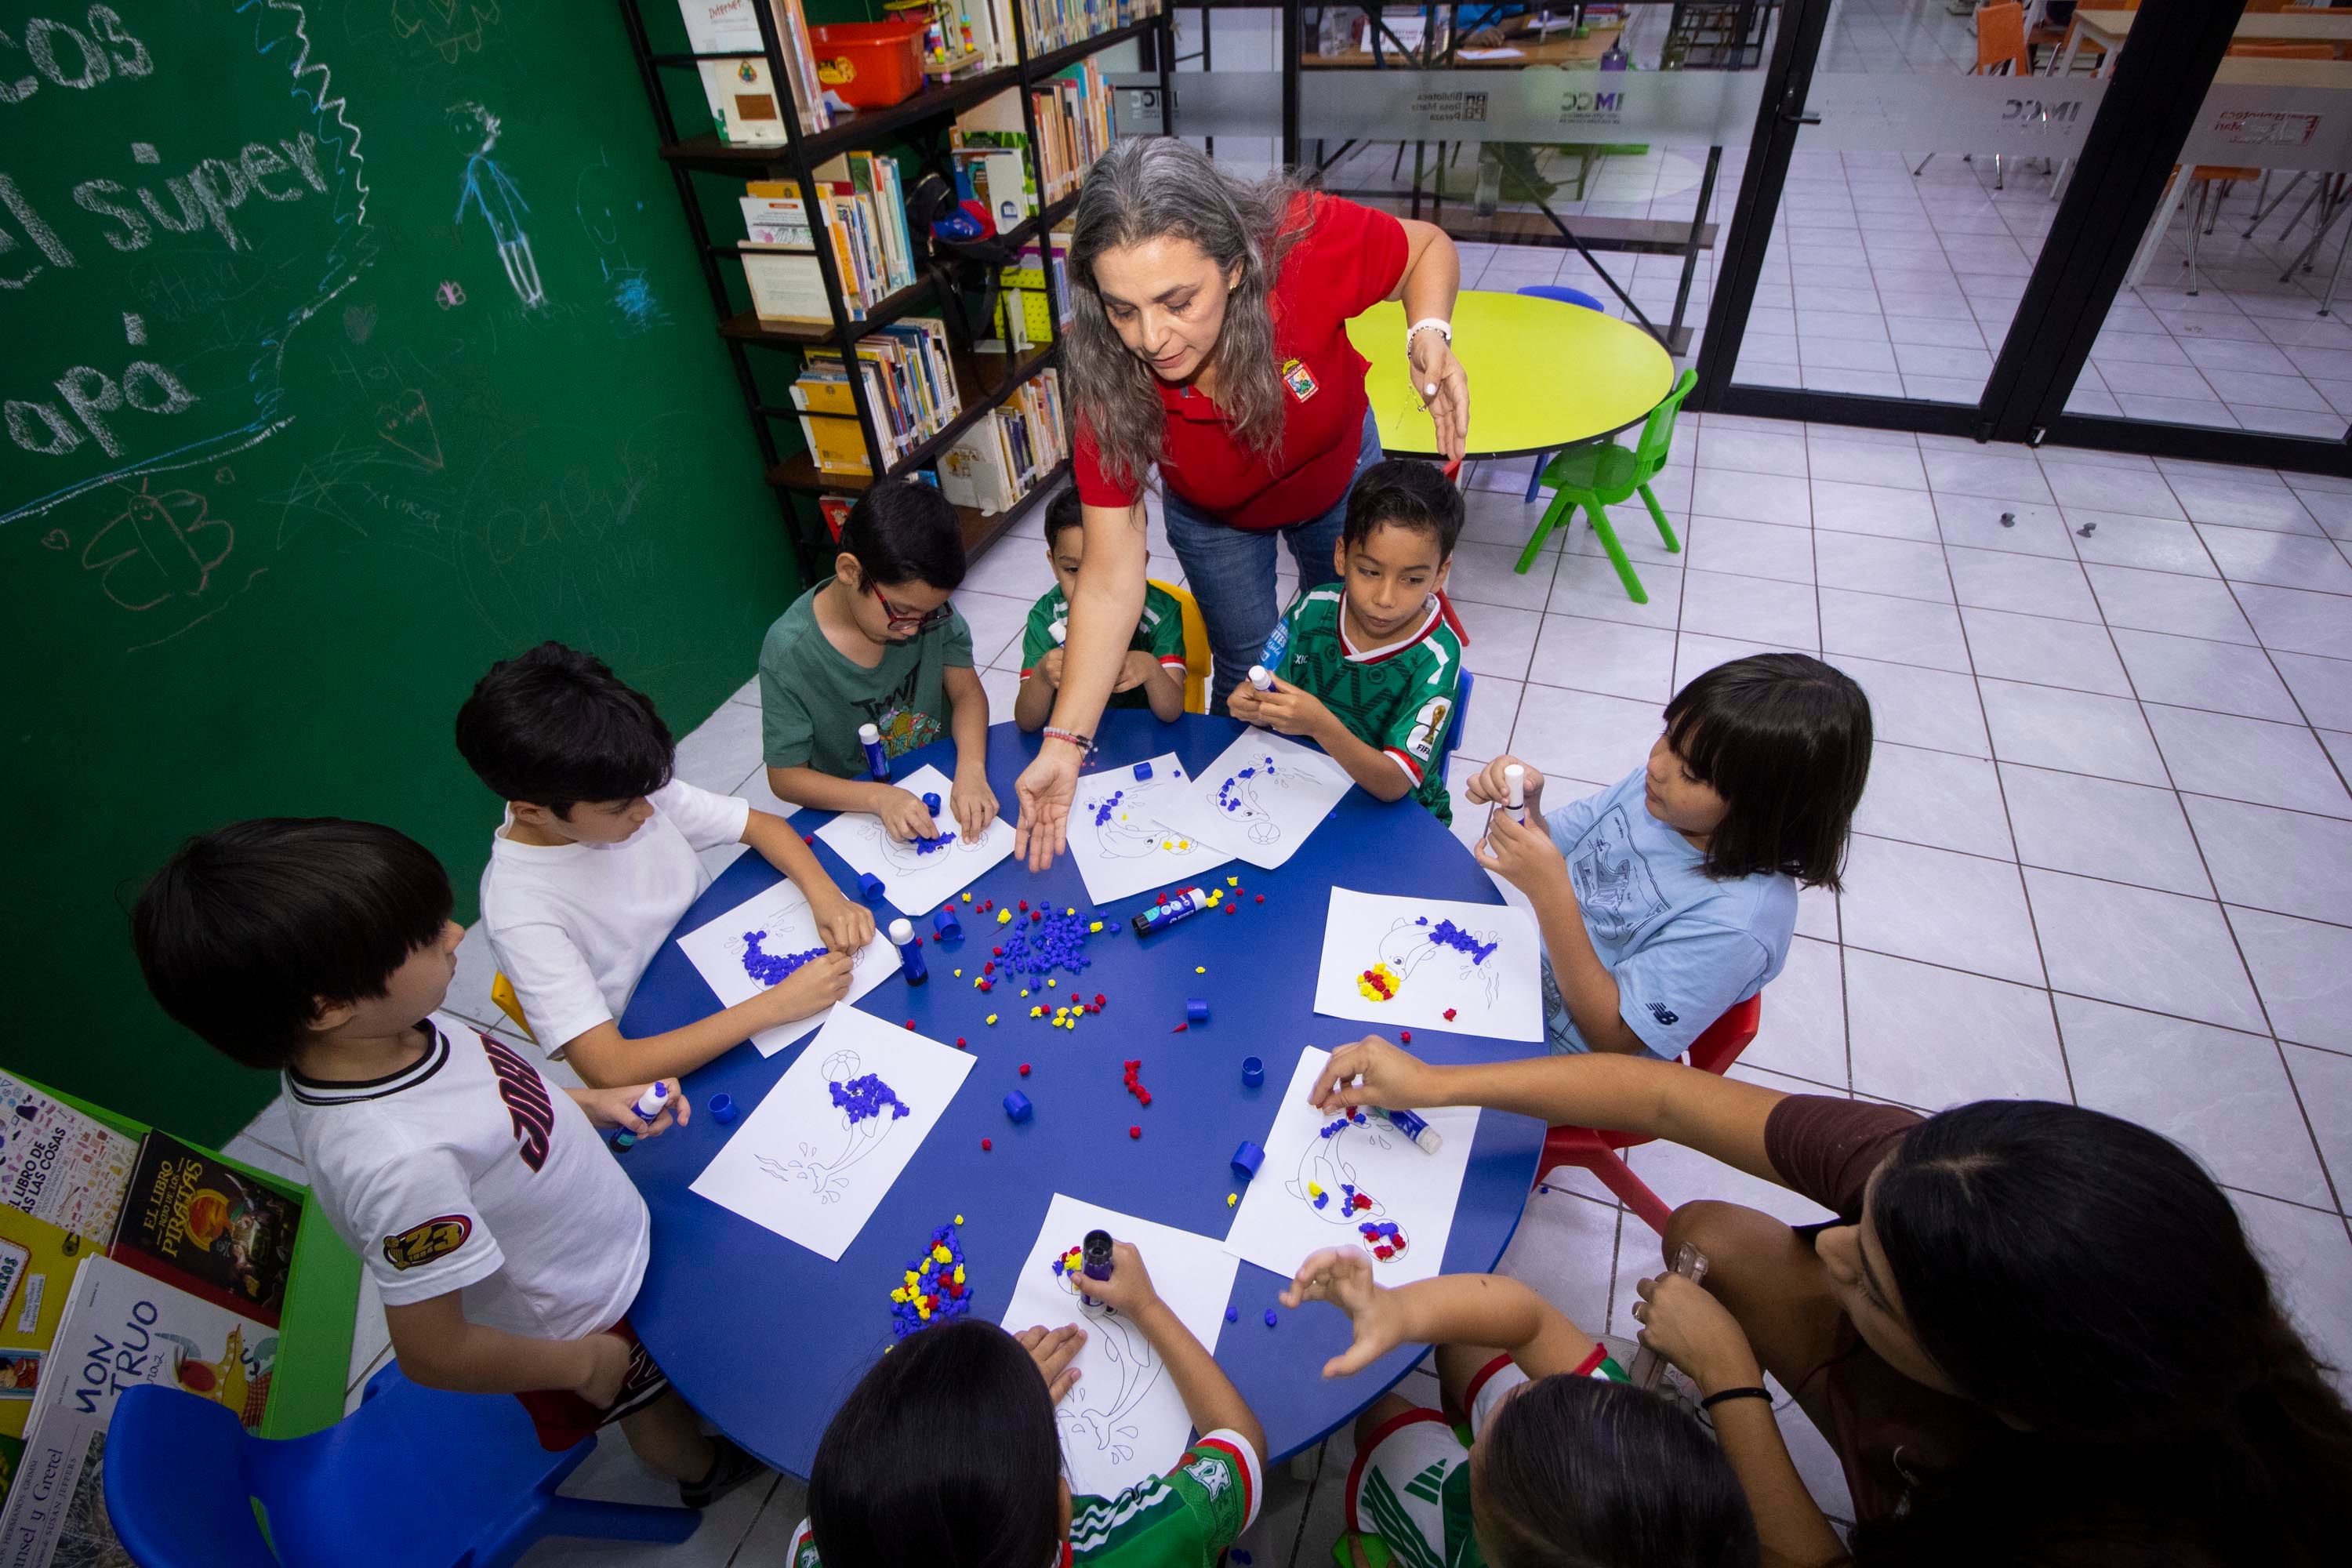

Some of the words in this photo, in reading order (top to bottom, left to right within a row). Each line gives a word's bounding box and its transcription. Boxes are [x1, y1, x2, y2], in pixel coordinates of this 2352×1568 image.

[3, 312, 201, 458] apá
[475, 1029, 555, 1174] JORD
[13, 1160, 37, 1197] LIBRO
[30, 1141, 45, 1159] DE
[20, 1196, 36, 1214] AS
[28, 1171, 46, 1196] LAS
[40, 1127, 66, 1171] COSAS
[150, 1160, 173, 1206] LIBRO
[143, 1208, 159, 1231] EL
[162, 1160, 203, 1258] PIRATAS
[405, 1224, 461, 1256] 23
[33, 1448, 63, 1501] Gretel
[45, 1501, 63, 1536] SUSAN
[58, 1457, 77, 1499] JEFFERS
[31, 1508, 46, 1522] y
[13, 1527, 36, 1568] ansel
